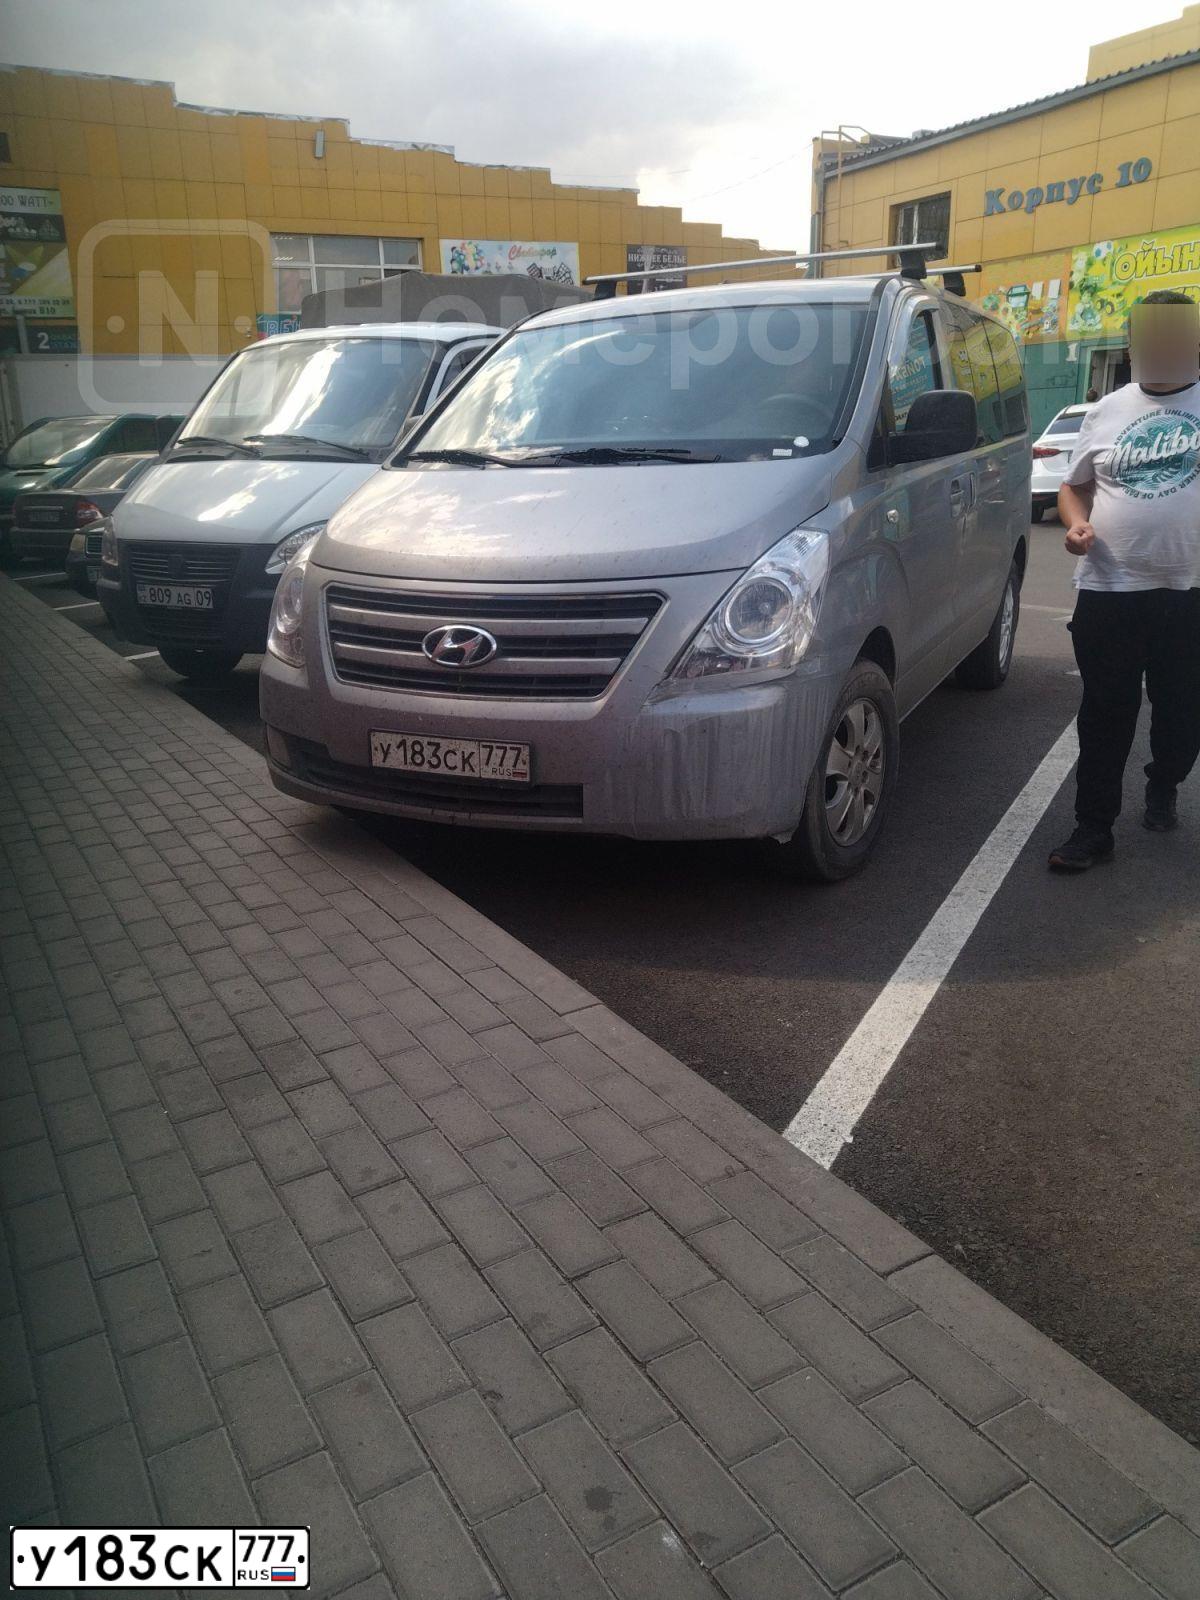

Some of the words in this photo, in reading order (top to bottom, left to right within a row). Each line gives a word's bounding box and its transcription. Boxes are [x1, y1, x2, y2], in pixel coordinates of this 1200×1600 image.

[983, 172, 1104, 216] Корпус
[1115, 157, 1153, 188] 10
[37, 332, 50, 349] 2
[149, 587, 171, 604] 809
[177, 593, 192, 605] AG
[196, 590, 211, 606] 09
[482, 744, 522, 768] 777
[491, 767, 512, 777] RUS
